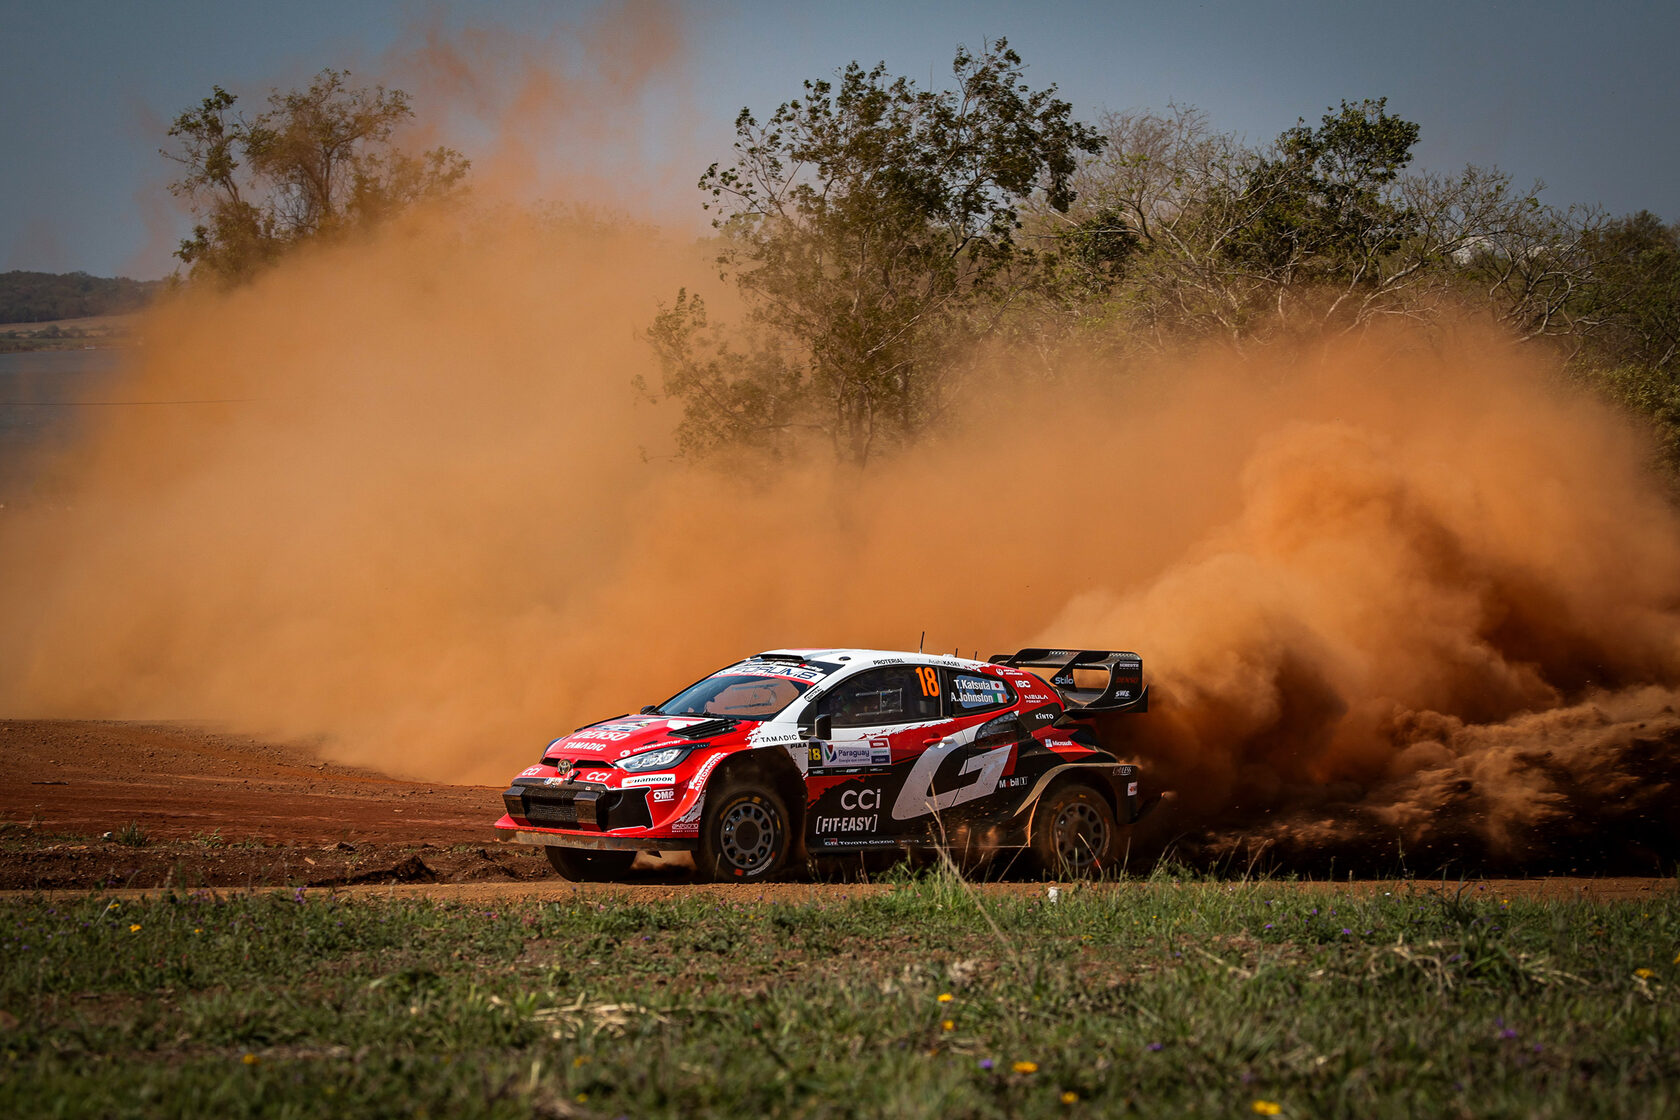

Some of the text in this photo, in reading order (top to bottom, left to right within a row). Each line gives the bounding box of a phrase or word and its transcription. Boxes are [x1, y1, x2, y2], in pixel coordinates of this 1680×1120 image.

[915, 666, 940, 697] 18
[1055, 674, 1073, 684] Stilo
[953, 679, 991, 690] T.Katsuta
[951, 692, 993, 703] A.Johnston
[573, 731, 630, 741] DENSO
[761, 734, 797, 742] TAMADIC
[564, 742, 606, 751] TAMADIC
[633, 740, 681, 752] codebeamer
[808, 748, 821, 760] 18
[838, 749, 869, 758] Paraguay
[695, 753, 728, 791] AUTOMOTIVE
[999, 778, 1019, 788] Mobil
[653, 790, 674, 799] OMP
